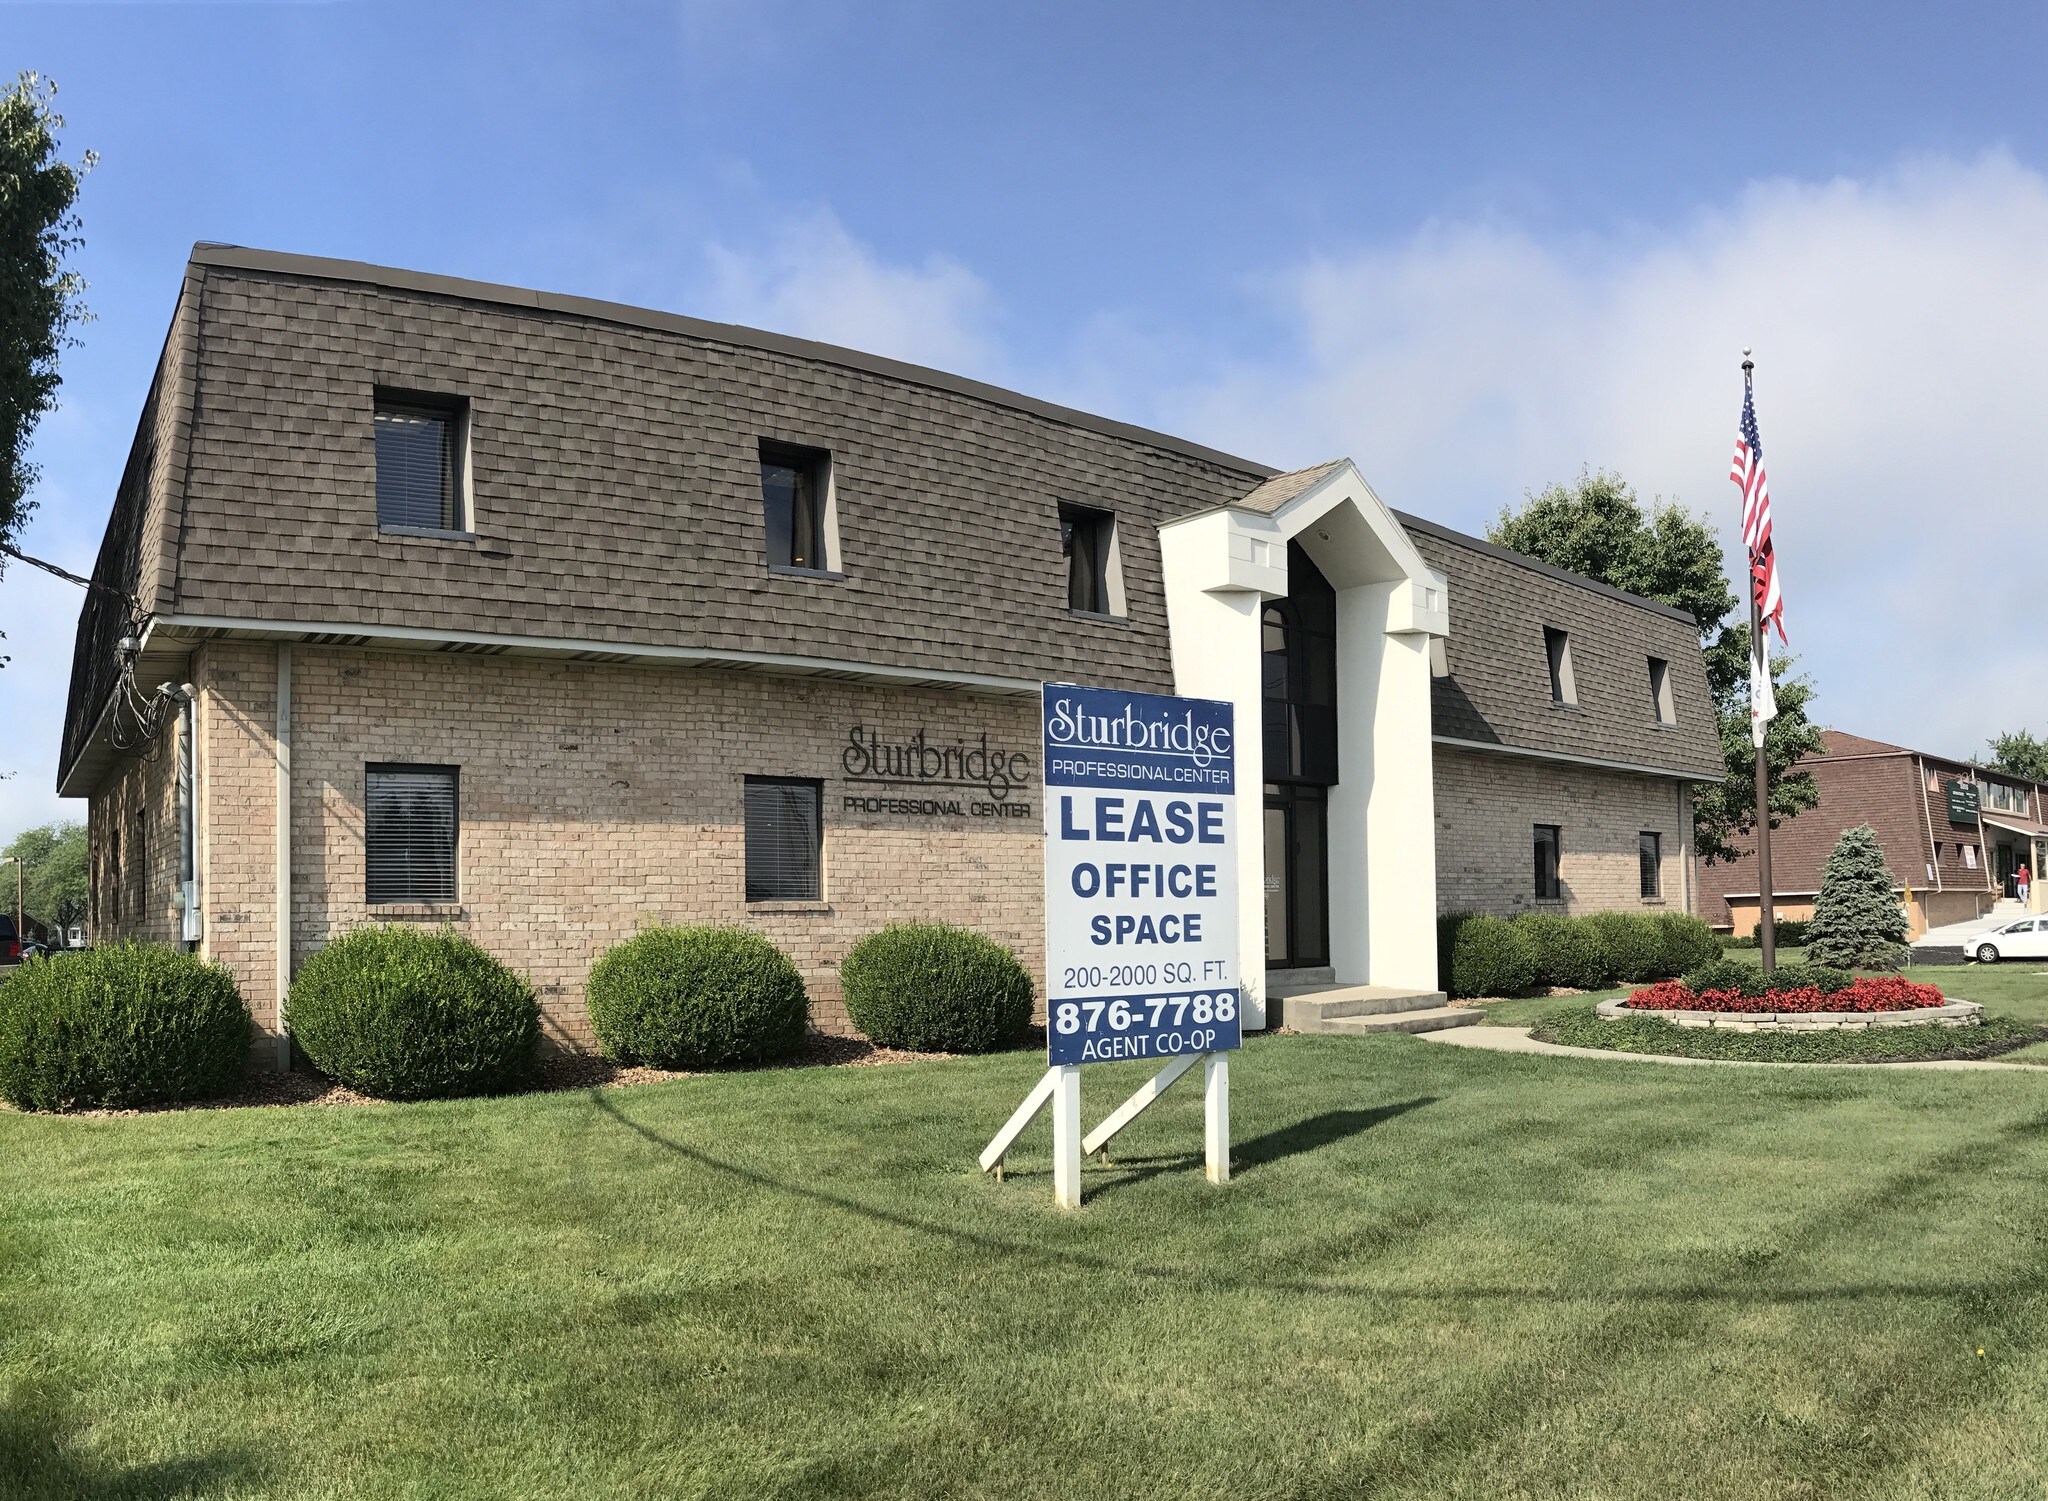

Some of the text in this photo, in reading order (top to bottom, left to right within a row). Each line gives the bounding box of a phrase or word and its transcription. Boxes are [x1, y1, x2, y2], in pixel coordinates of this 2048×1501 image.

[1048, 698, 1231, 768] Sturbridge
[842, 724, 1031, 800] Sturbridge
[1052, 759, 1230, 785] PROFESSIONAL CENTER
[843, 796, 1031, 818] PROFESSIONAL CENTER
[1060, 795, 1225, 845] LEASE
[1071, 862, 1217, 899] OFFICE
[1090, 913, 1203, 946] SPACE
[1063, 959, 1228, 989] 200-2000 SQ. FT.
[1055, 991, 1236, 1035] 876-7788
[1081, 1028, 1216, 1061] AGENT CO-OP
